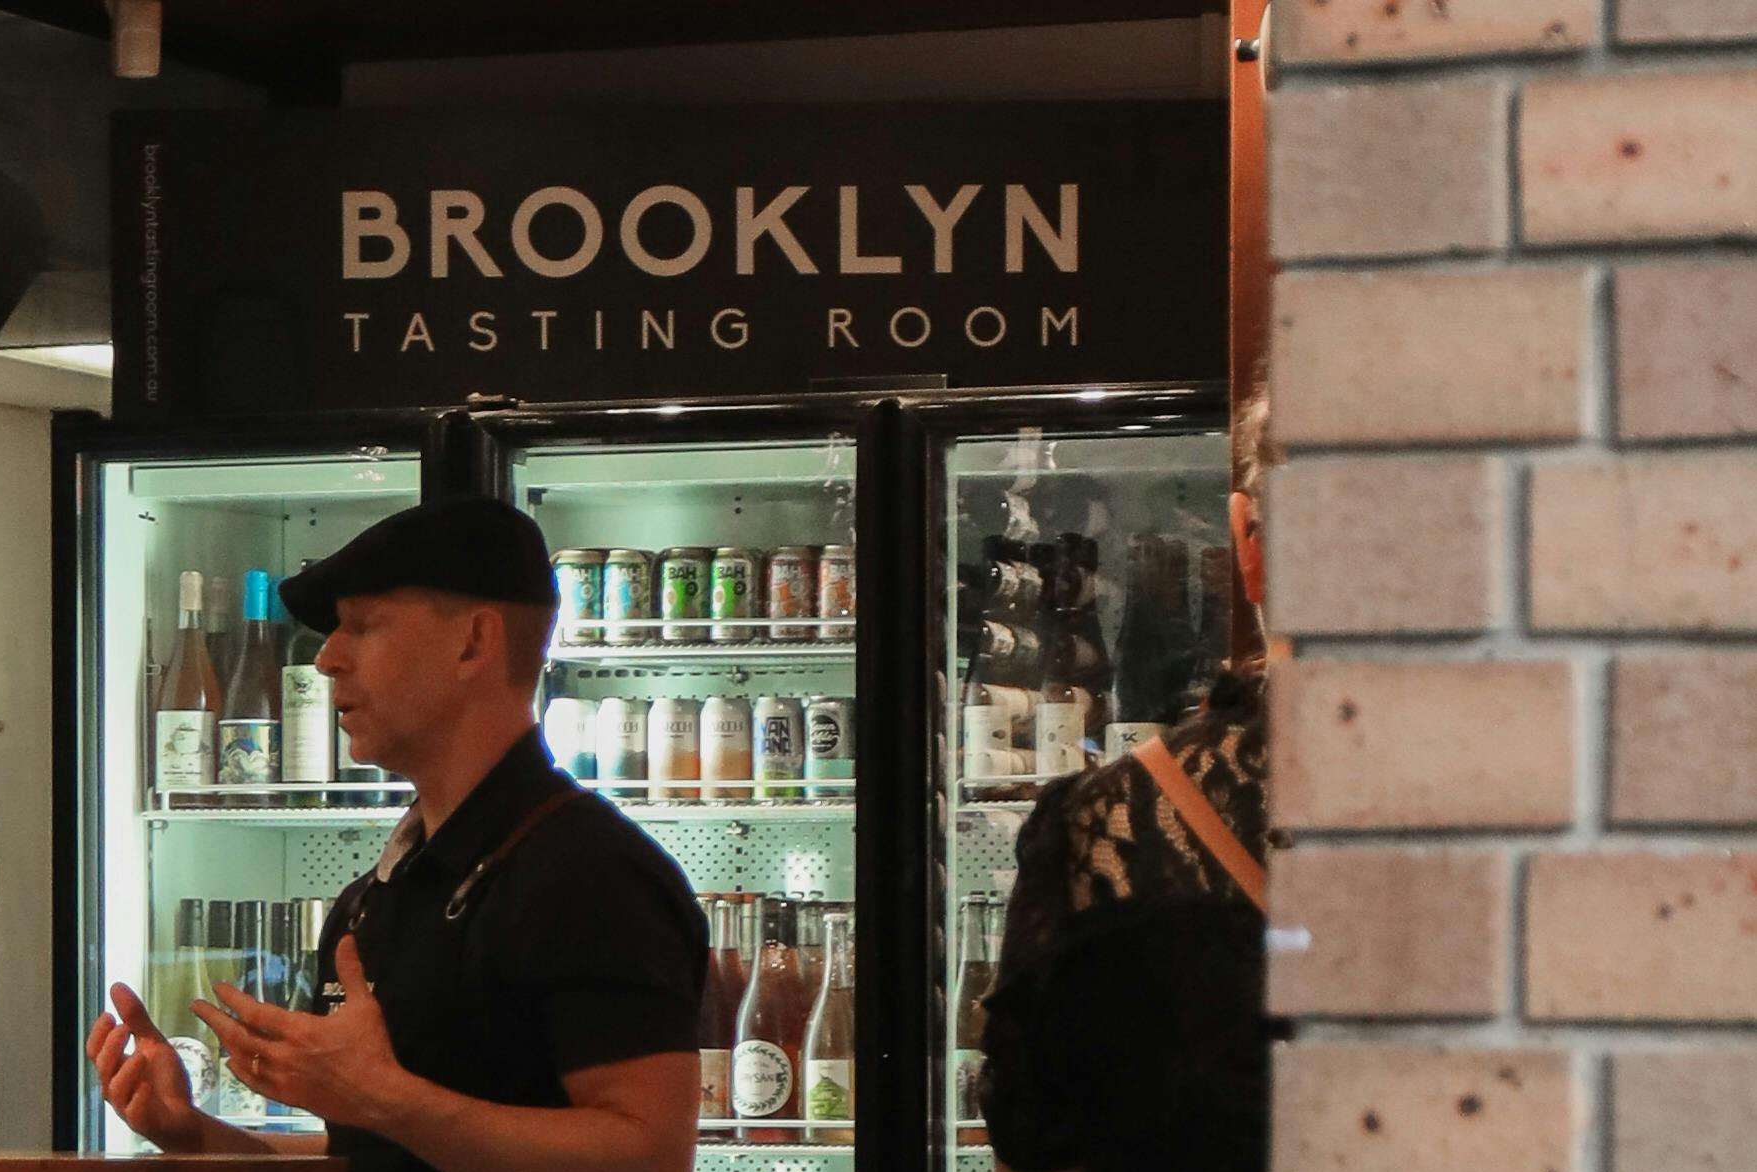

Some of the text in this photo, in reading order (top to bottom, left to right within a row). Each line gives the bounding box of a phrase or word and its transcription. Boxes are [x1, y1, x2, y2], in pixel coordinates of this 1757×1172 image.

[341, 183, 1080, 279] BROOKLYN
[343, 305, 1079, 353] TASTING ROOM
